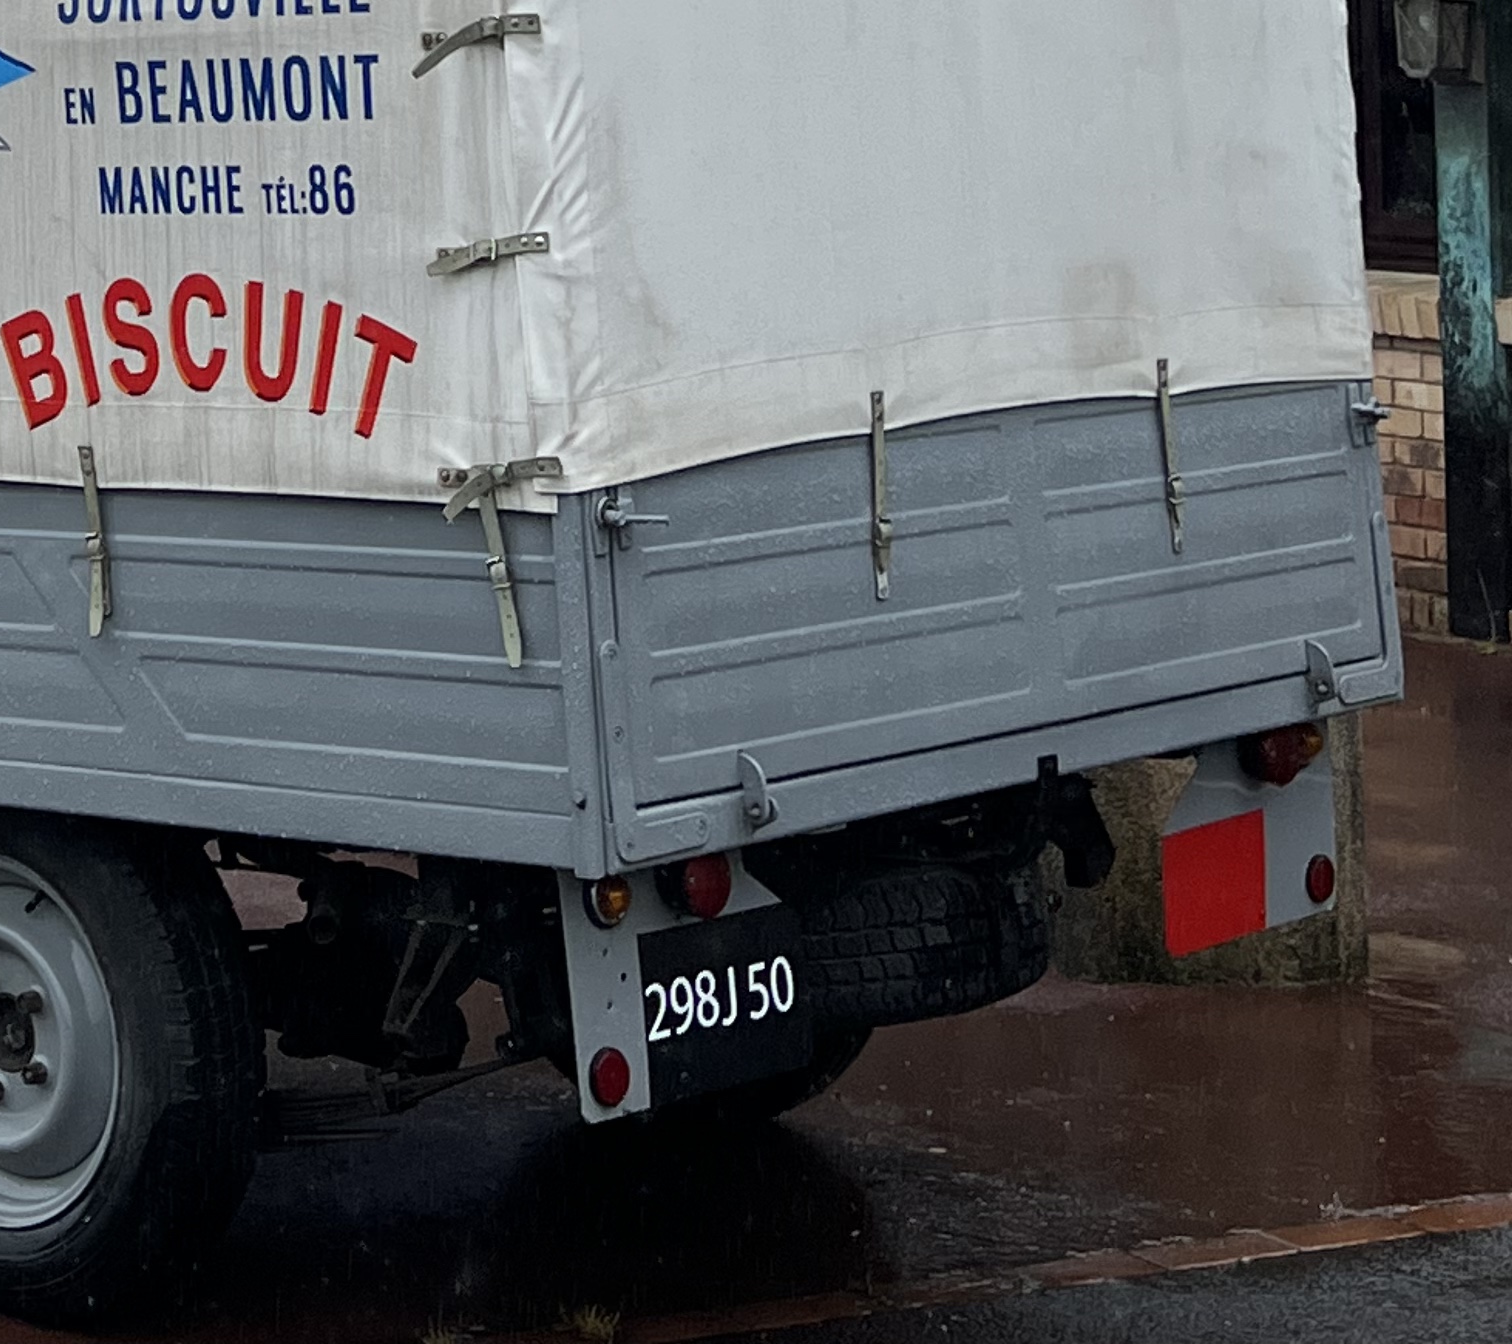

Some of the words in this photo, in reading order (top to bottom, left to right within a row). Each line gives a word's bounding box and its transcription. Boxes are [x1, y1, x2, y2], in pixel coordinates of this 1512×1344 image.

[64, 87, 96, 124] EN
[115, 54, 379, 124] BEAUMONT
[98, 163, 245, 215] MANCHE
[0, 272, 417, 440] BISCUIT
